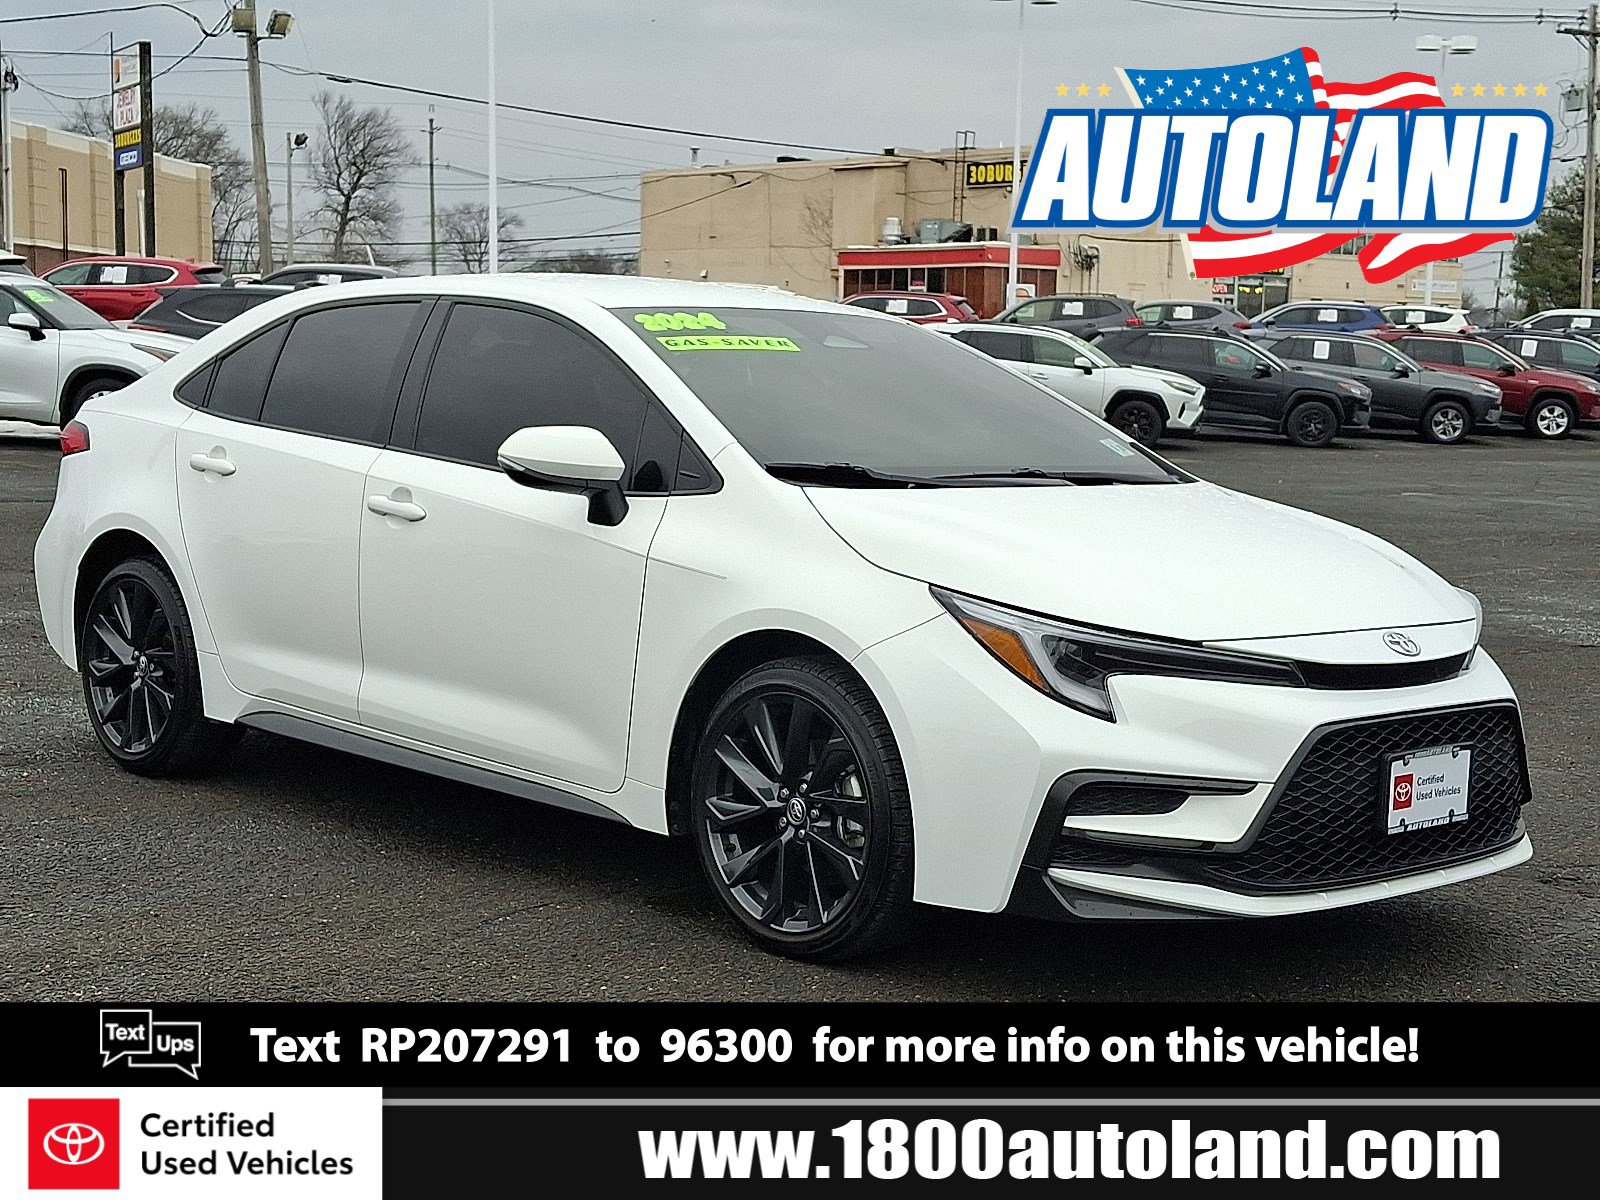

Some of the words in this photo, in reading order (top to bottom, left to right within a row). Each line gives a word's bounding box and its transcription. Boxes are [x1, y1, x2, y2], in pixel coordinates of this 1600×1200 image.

[120, 151, 138, 165] GEICO
[969, 164, 1026, 183] 30BUR
[634, 312, 726, 331] 2024
[664, 338, 792, 348] GAS-SAVER
[1417, 773, 1445, 786] Certified
[1416, 789, 1433, 801] Used
[1434, 785, 1461, 798] Vehicles
[1407, 817, 1449, 831] AUTOLAND
